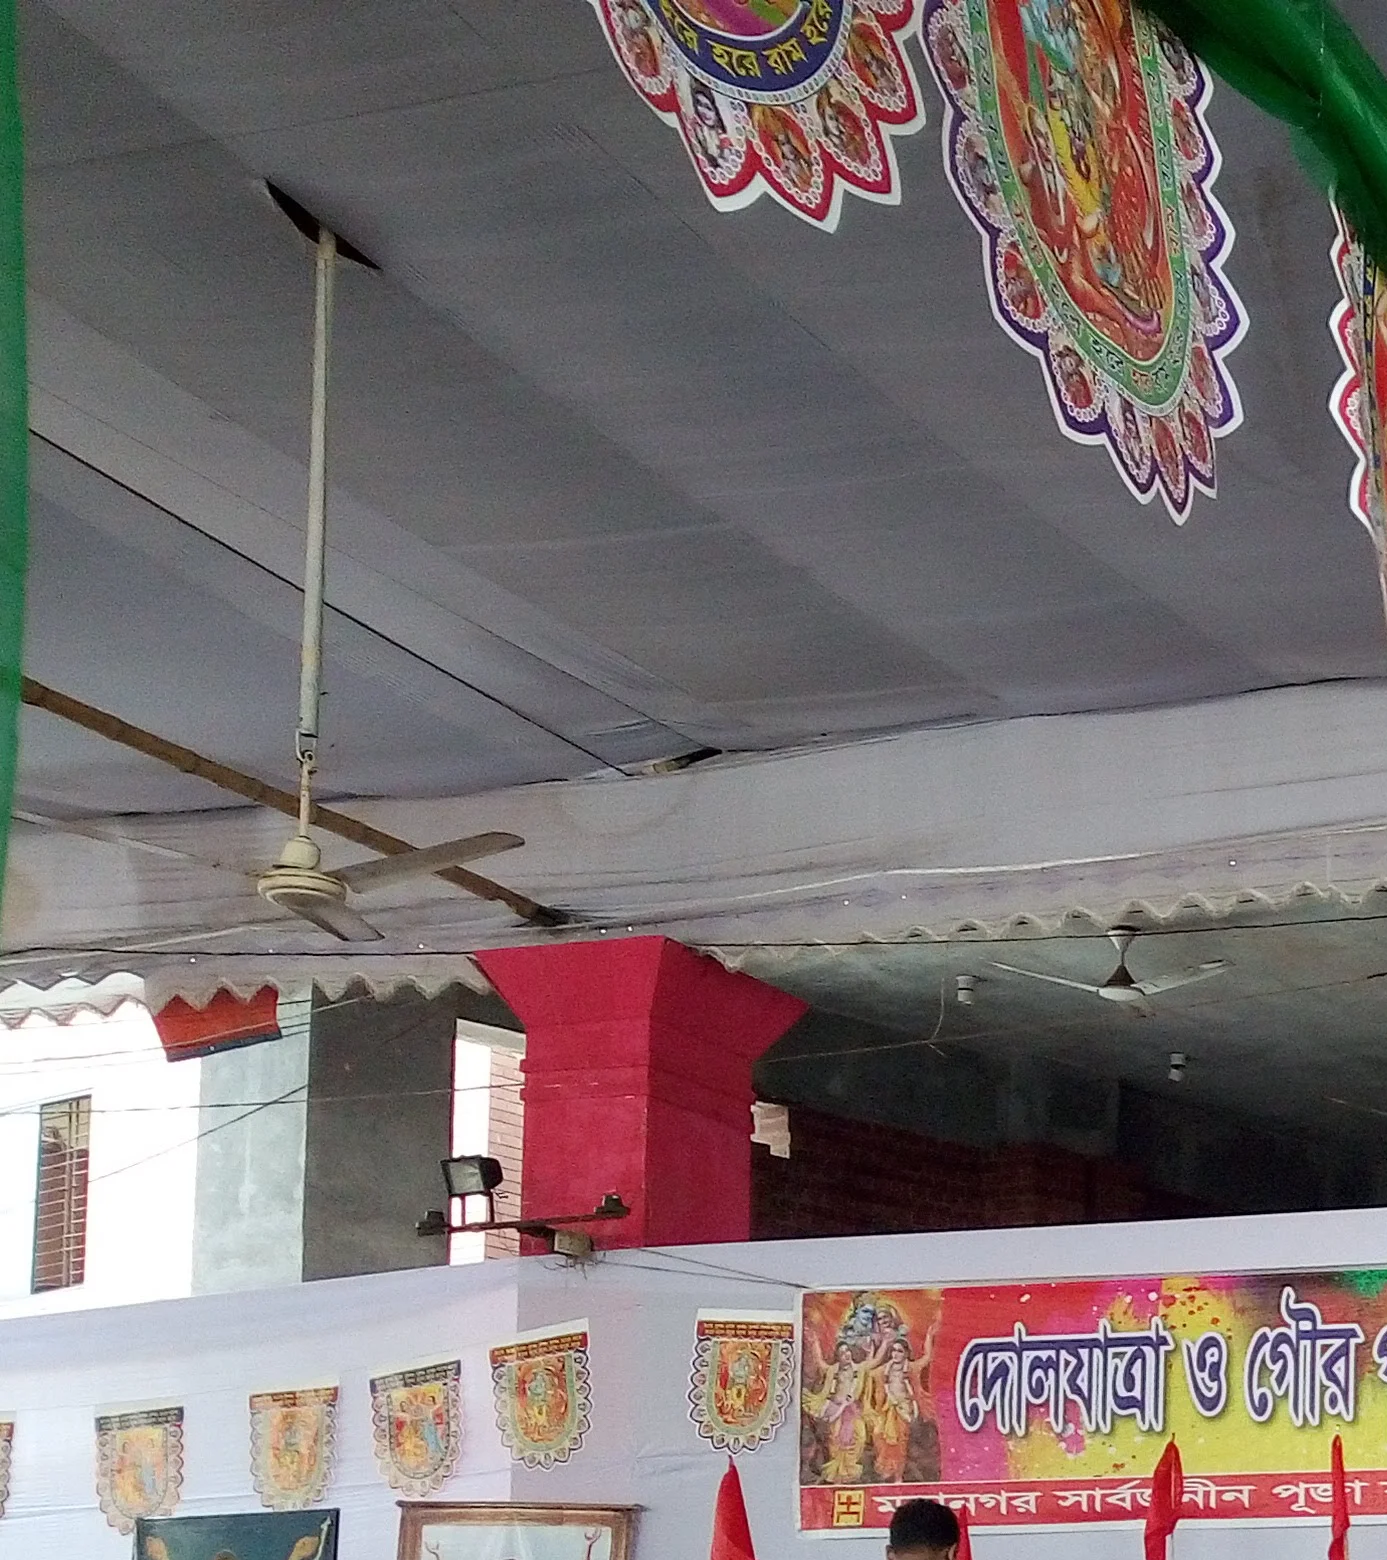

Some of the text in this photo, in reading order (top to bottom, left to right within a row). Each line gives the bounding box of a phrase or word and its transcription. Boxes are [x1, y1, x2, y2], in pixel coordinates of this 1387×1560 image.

[705, 38, 762, 79] হরে
[762, 37, 809, 75] রাম
[955, 1316, 1176, 1437] দোলযাত্রা
[1182, 1330, 1228, 1418] ও
[1244, 1284, 1366, 1427] গৌর
